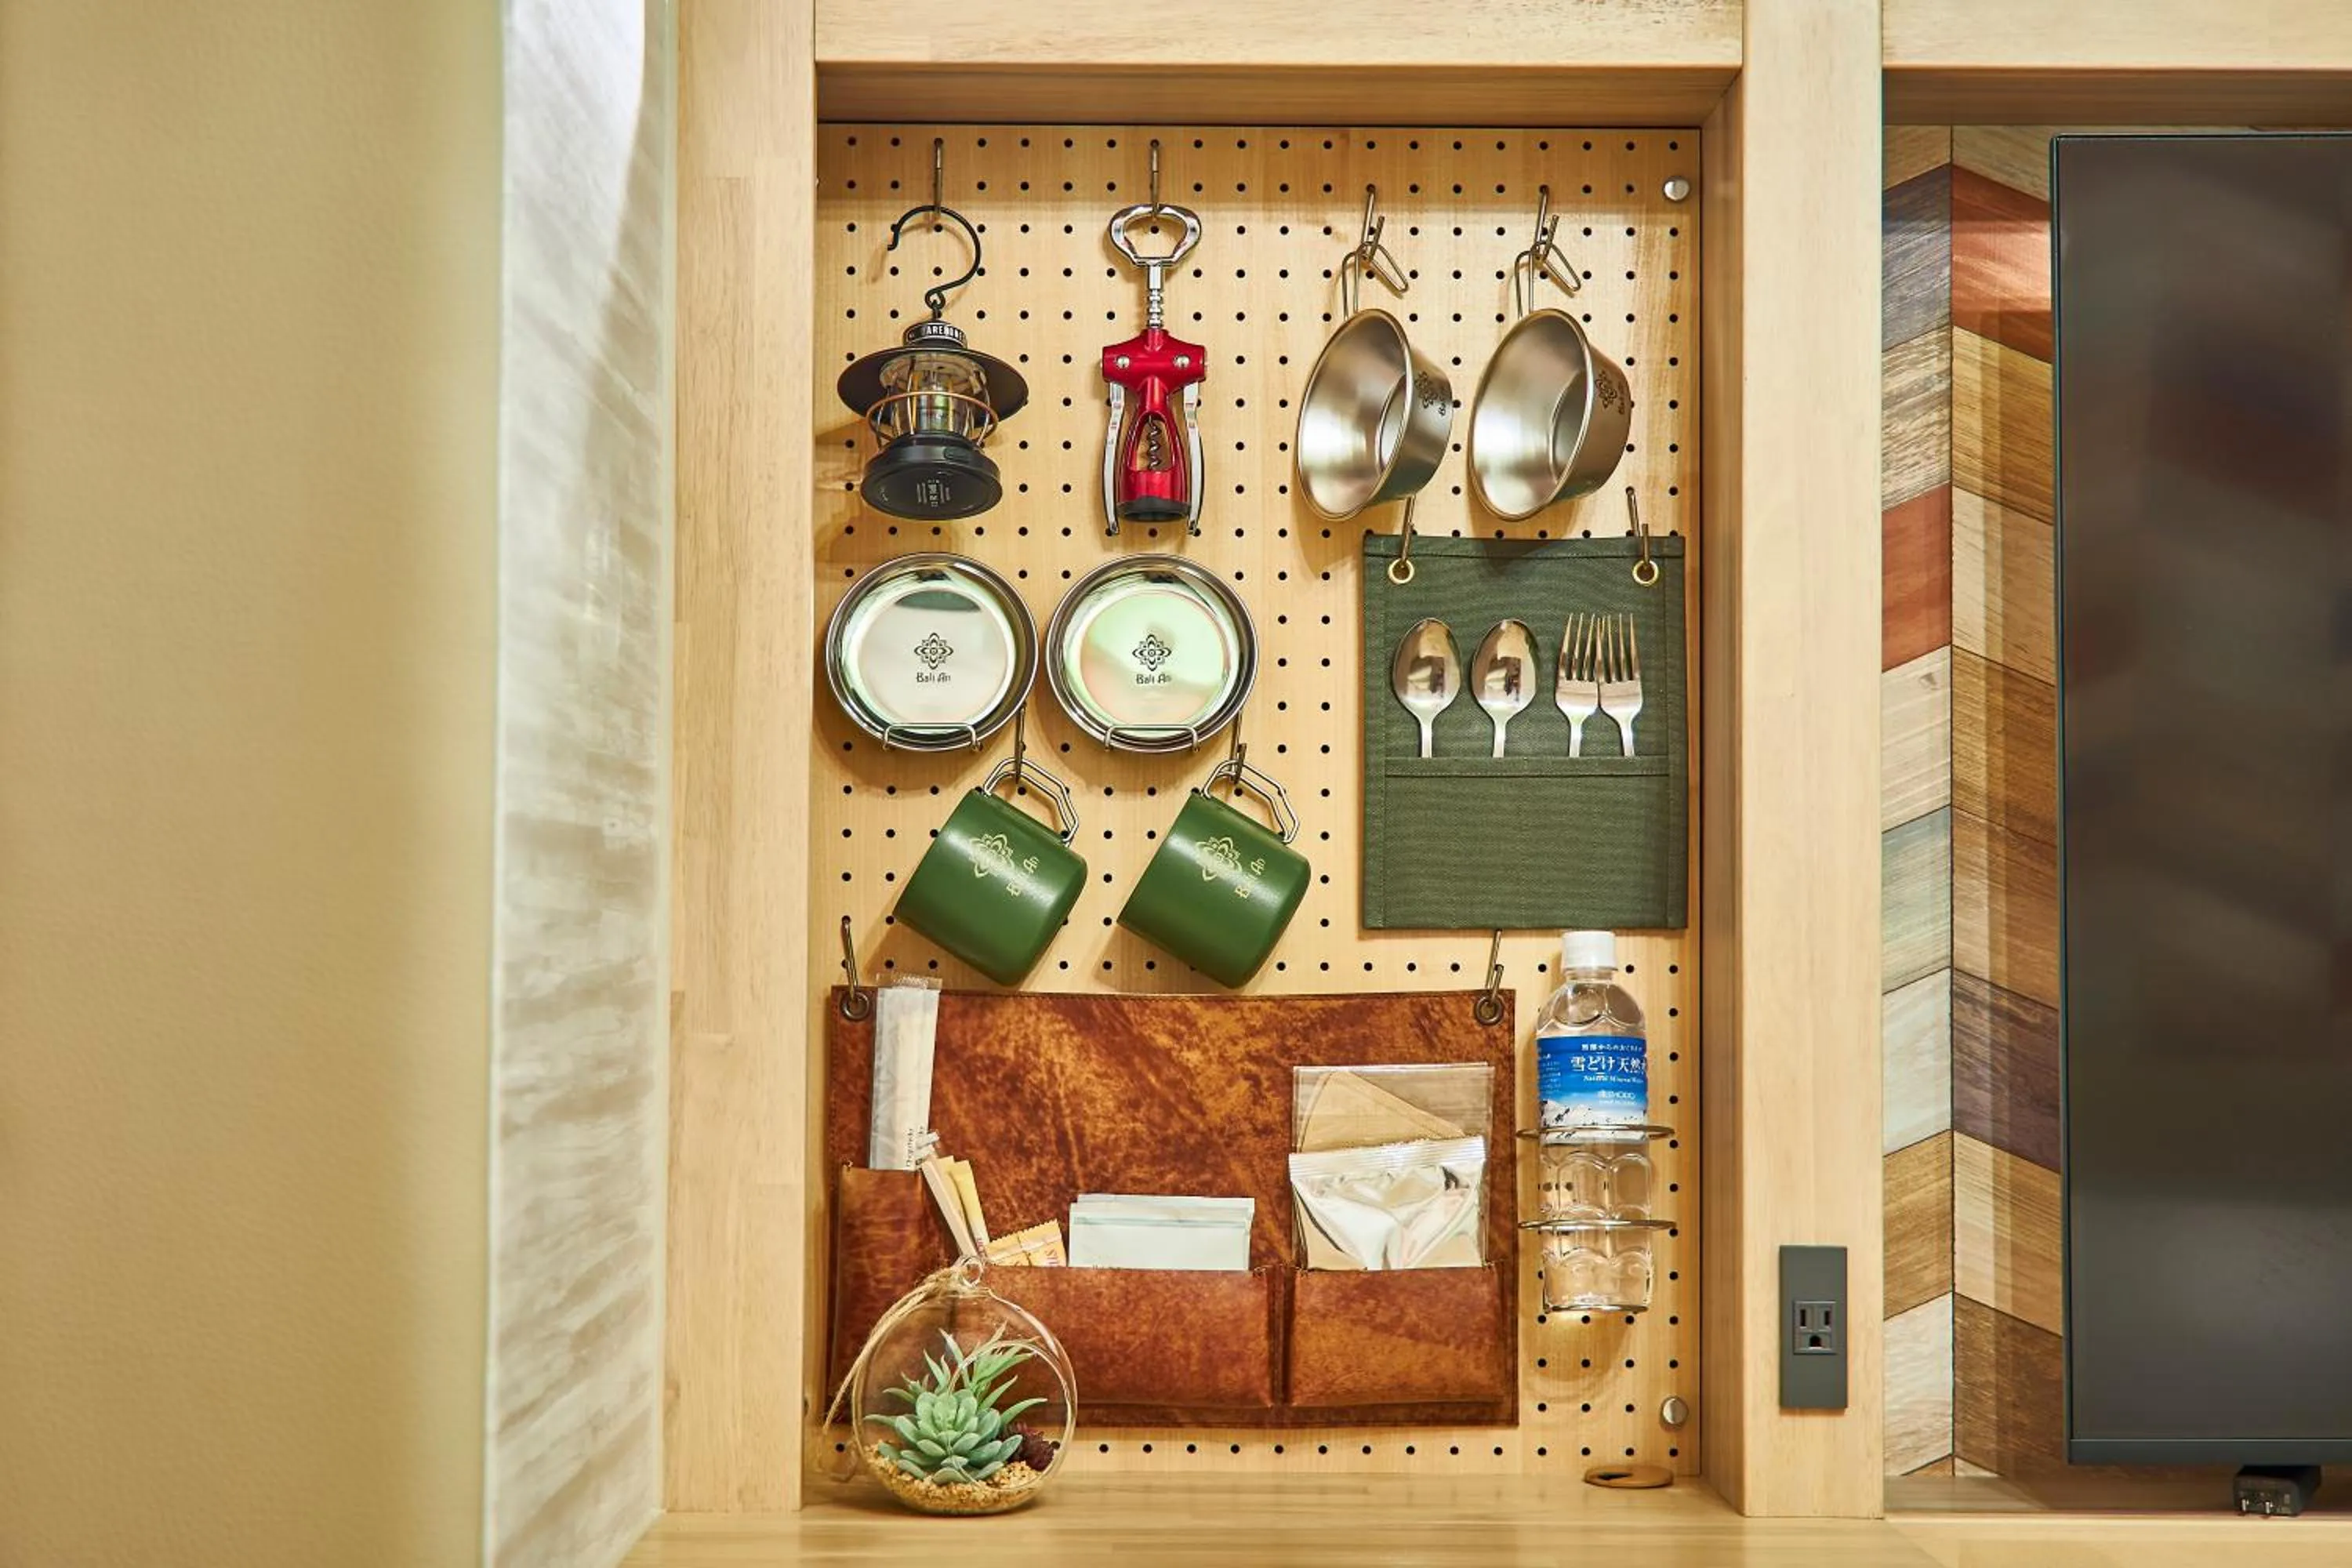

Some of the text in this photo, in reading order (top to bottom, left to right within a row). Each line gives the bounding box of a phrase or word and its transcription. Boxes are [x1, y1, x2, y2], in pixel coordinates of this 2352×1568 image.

[916, 672, 951, 683] Bali An
[1136, 673, 1155, 684] Bali
[1023, 856, 1040, 874] An
[1250, 858, 1265, 876] An
